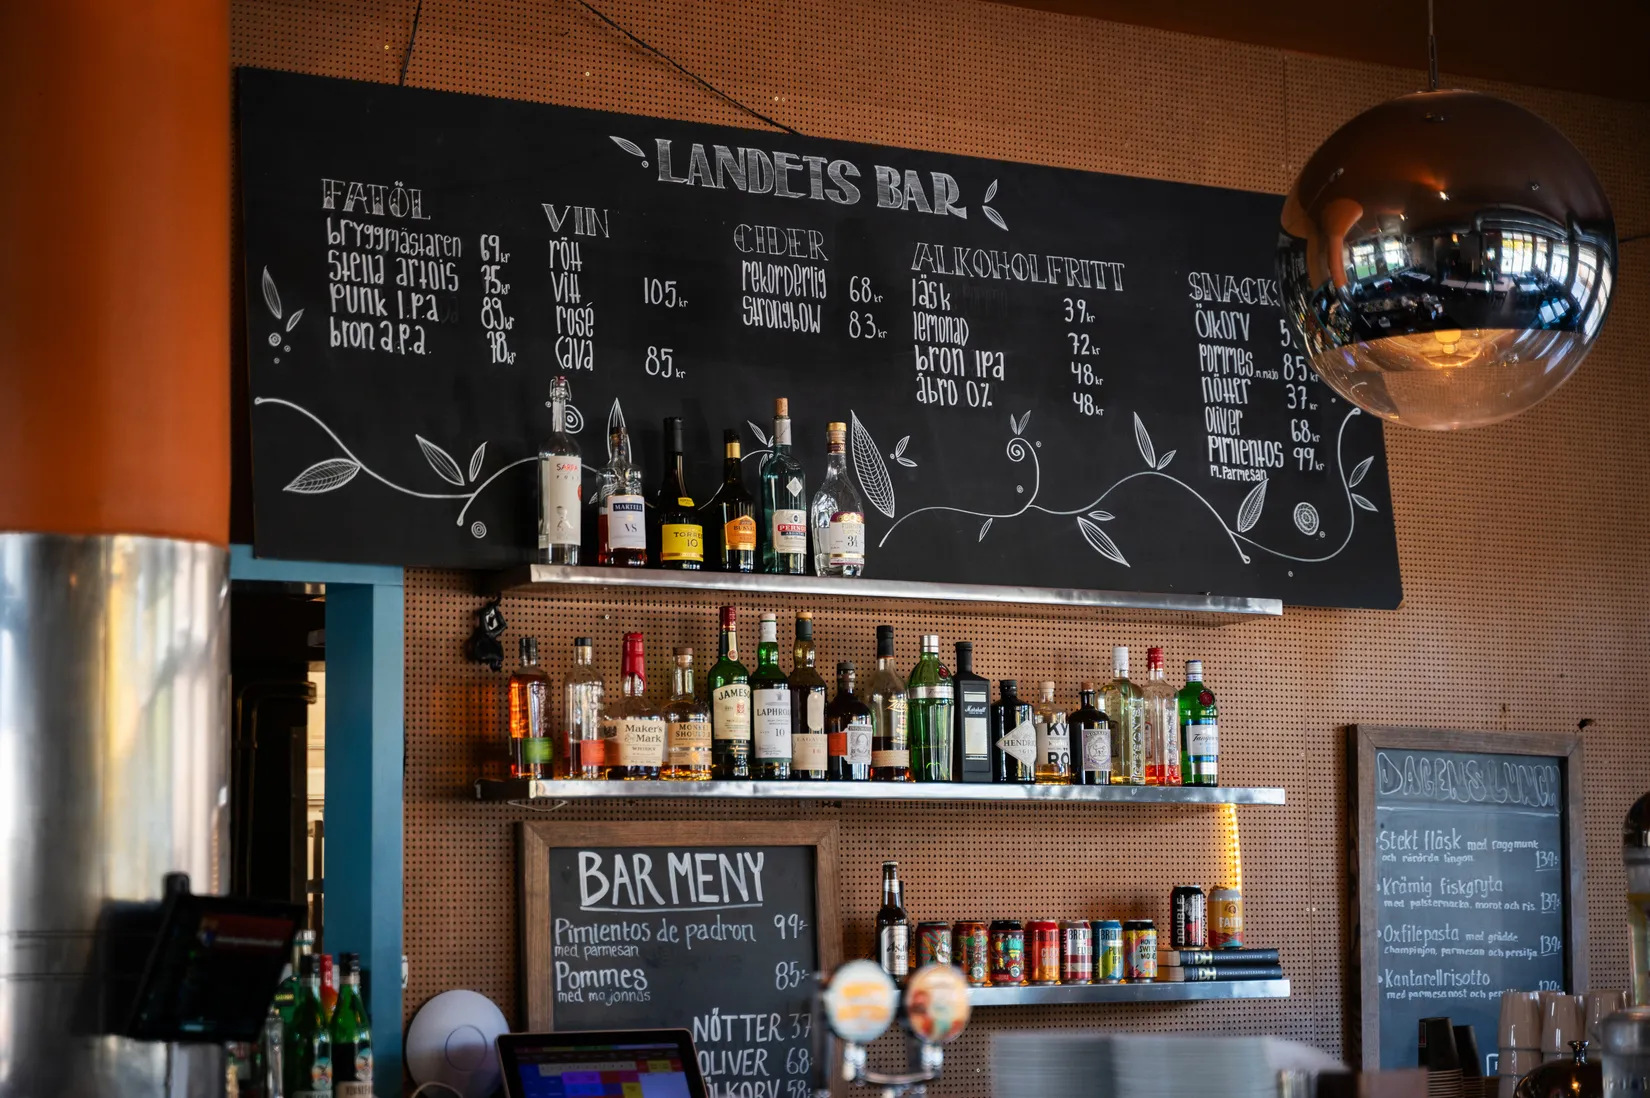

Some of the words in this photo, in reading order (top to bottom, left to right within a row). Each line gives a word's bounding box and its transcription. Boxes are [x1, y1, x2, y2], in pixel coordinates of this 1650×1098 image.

[654, 138, 862, 206] LANDETS
[874, 164, 967, 220] BAR
[321, 178, 431, 220] FATÖL
[541, 203, 610, 238] VIN
[326, 216, 461, 258] bryggmästaren
[733, 223, 829, 261] CIDER
[549, 237, 583, 272] rött
[911, 242, 1125, 291] ALKOHOLFRITT
[395, 257, 459, 292] artois
[912, 274, 951, 311] läsk
[329, 316, 375, 350] bron
[556, 301, 594, 338] rosé
[914, 344, 965, 377] bron
[916, 372, 958, 406] åbro
[1201, 373, 1251, 404] nötter
[625, 523, 637, 532] VS
[687, 539, 698, 547] 10
[625, 724, 662, 733] Maker's
[636, 734, 662, 743] Mark
[775, 728, 785, 738] 10
[1377, 752, 1487, 803] DAGENS
[1380, 830, 1419, 850] Stekt
[1425, 828, 1462, 850] fläsk
[1467, 838, 1487, 851] med
[1492, 840, 1539, 853] raggmunk
[1382, 854, 1396, 862] och
[578, 851, 665, 906] BAR
[667, 852, 764, 904] MENY
[1383, 876, 1432, 898] Krämig
[1440, 876, 1503, 898] fiskgryta
[1384, 899, 1405, 908] med
[1475, 901, 1502, 909] morot
[1504, 901, 1519, 910] och
[555, 918, 651, 945] Pimientos
[657, 918, 680, 943] de
[685, 914, 756, 950] padron
[1383, 923, 1459, 946] Oxfilépasta
[1466, 932, 1484, 941] med
[554, 944, 580, 957] med
[583, 945, 639, 960] parmesan
[1441, 947, 1484, 957] parmesan
[1488, 948, 1504, 957] och
[555, 961, 648, 991] Pommes
[1385, 969, 1490, 988] Kantarellrisotto
[558, 988, 584, 1002] med
[1387, 991, 1406, 999] med
[1470, 990, 1486, 999] och
[693, 1007, 785, 1043] NÖTTER
[697, 1048, 770, 1076] OLIVER
